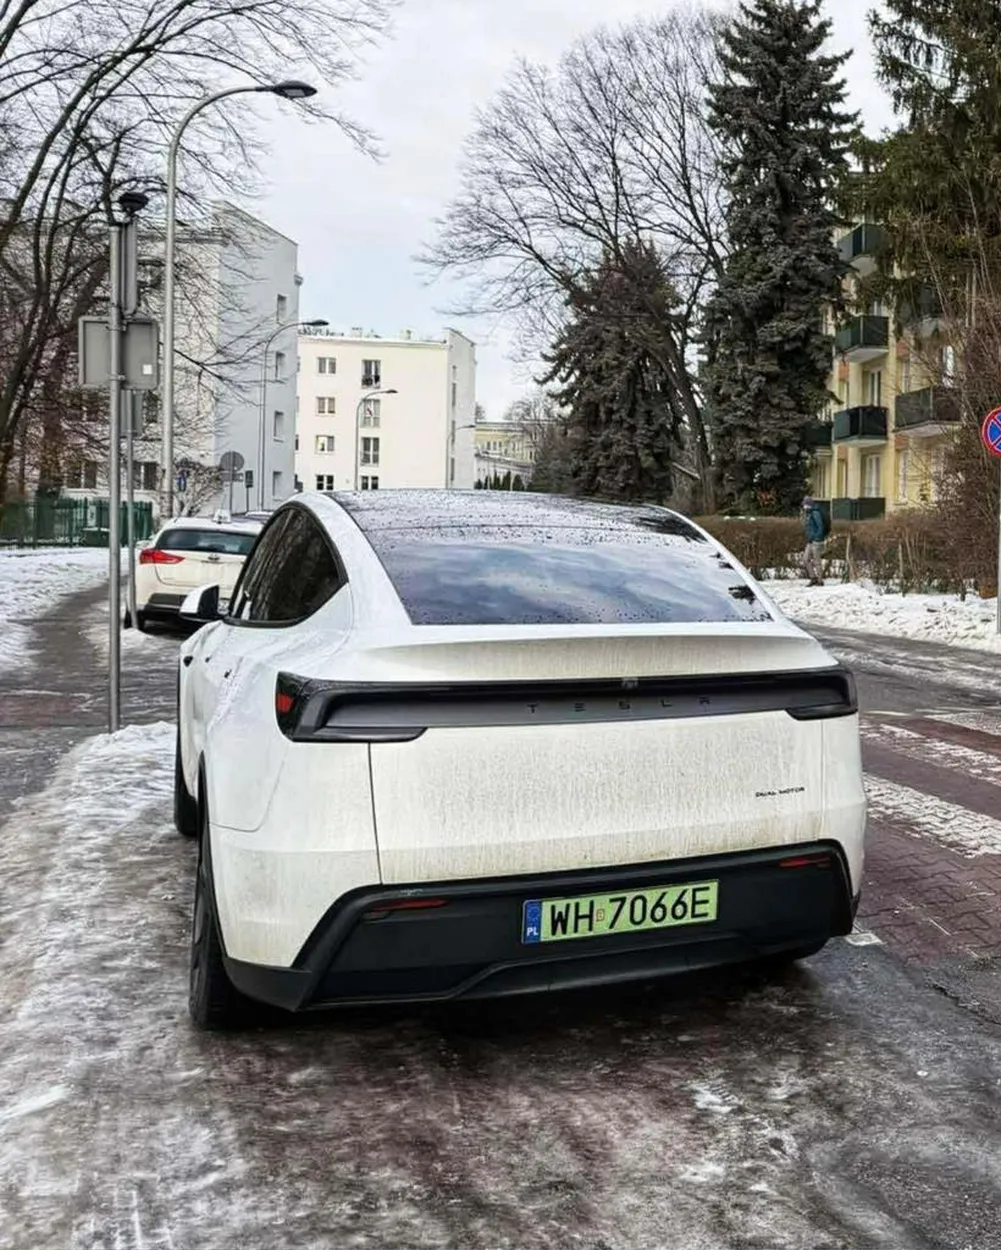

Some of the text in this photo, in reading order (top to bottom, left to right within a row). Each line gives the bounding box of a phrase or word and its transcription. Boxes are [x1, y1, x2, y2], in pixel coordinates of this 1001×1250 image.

[527, 697, 711, 714] TESLA
[551, 887, 711, 936] WH 7066E
[526, 926, 539, 936] PL
